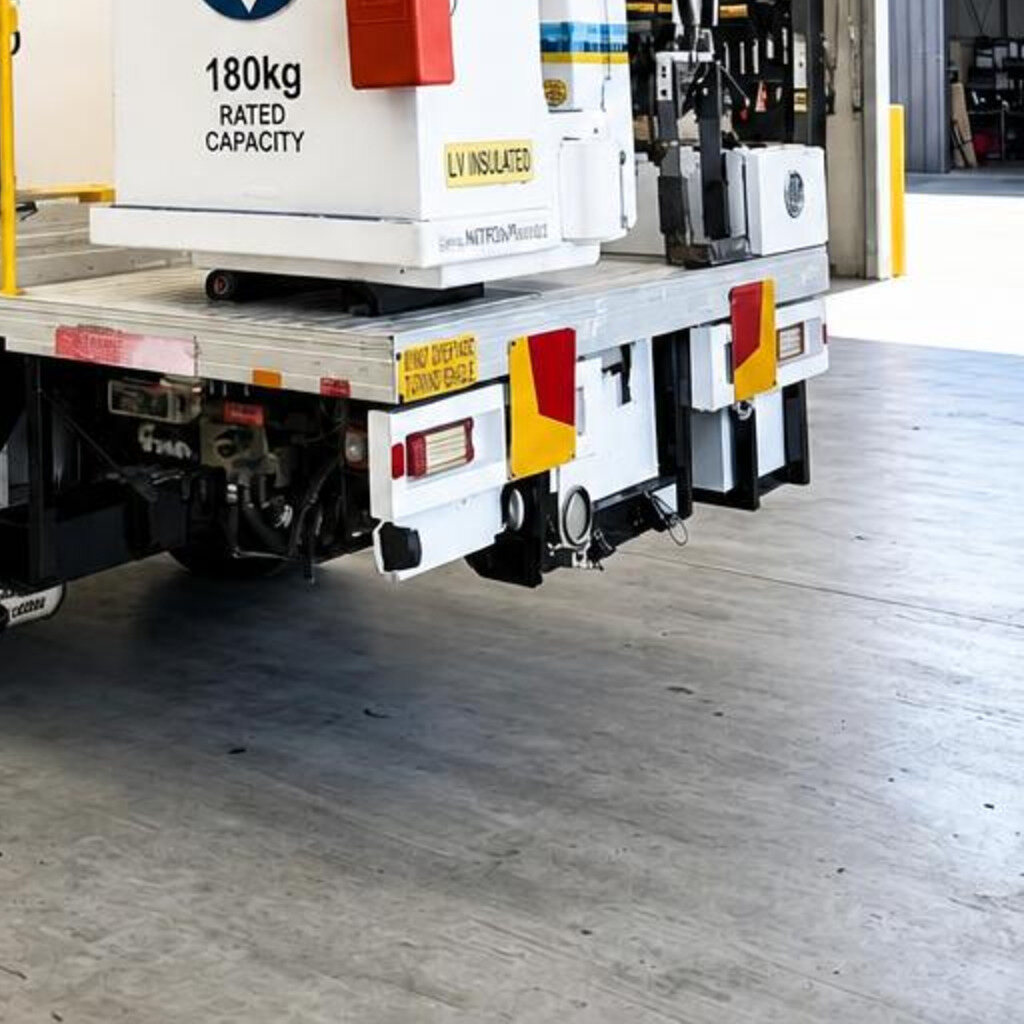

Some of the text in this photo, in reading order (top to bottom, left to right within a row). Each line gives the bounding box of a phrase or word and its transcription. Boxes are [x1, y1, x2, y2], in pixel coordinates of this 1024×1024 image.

[205, 55, 301, 99] 180kg
[219, 103, 285, 126] RATED
[205, 130, 305, 153] CAPACITY
[447, 147, 531, 178] LV INSULATED
